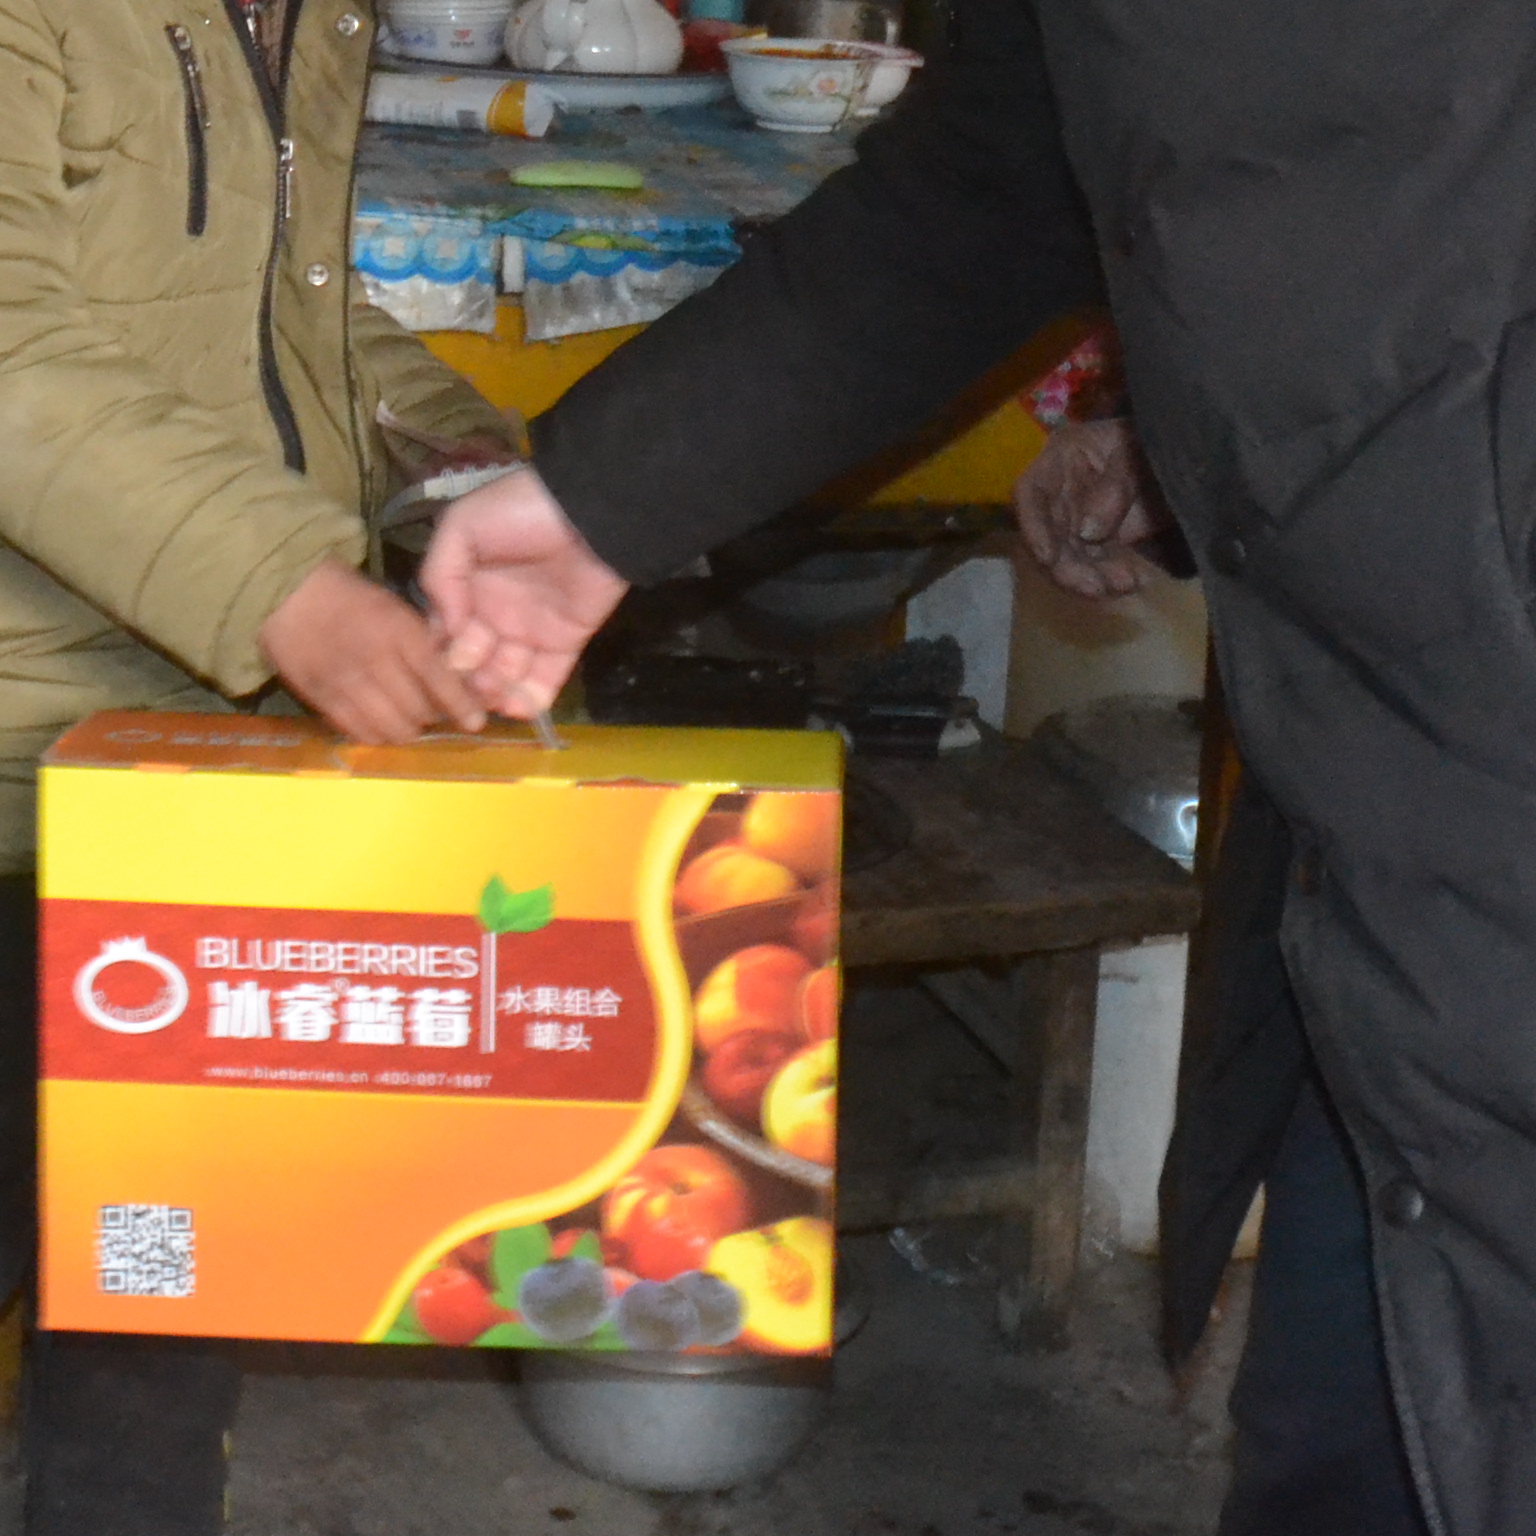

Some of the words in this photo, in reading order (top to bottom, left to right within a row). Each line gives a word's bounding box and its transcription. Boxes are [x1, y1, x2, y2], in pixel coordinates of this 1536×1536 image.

[195, 935, 479, 979] BLUEBERRIES
[205, 980, 474, 1048] 冰睿蓝莓
[498, 985, 624, 1017] 水果组合
[524, 1021, 594, 1052] 罐头
